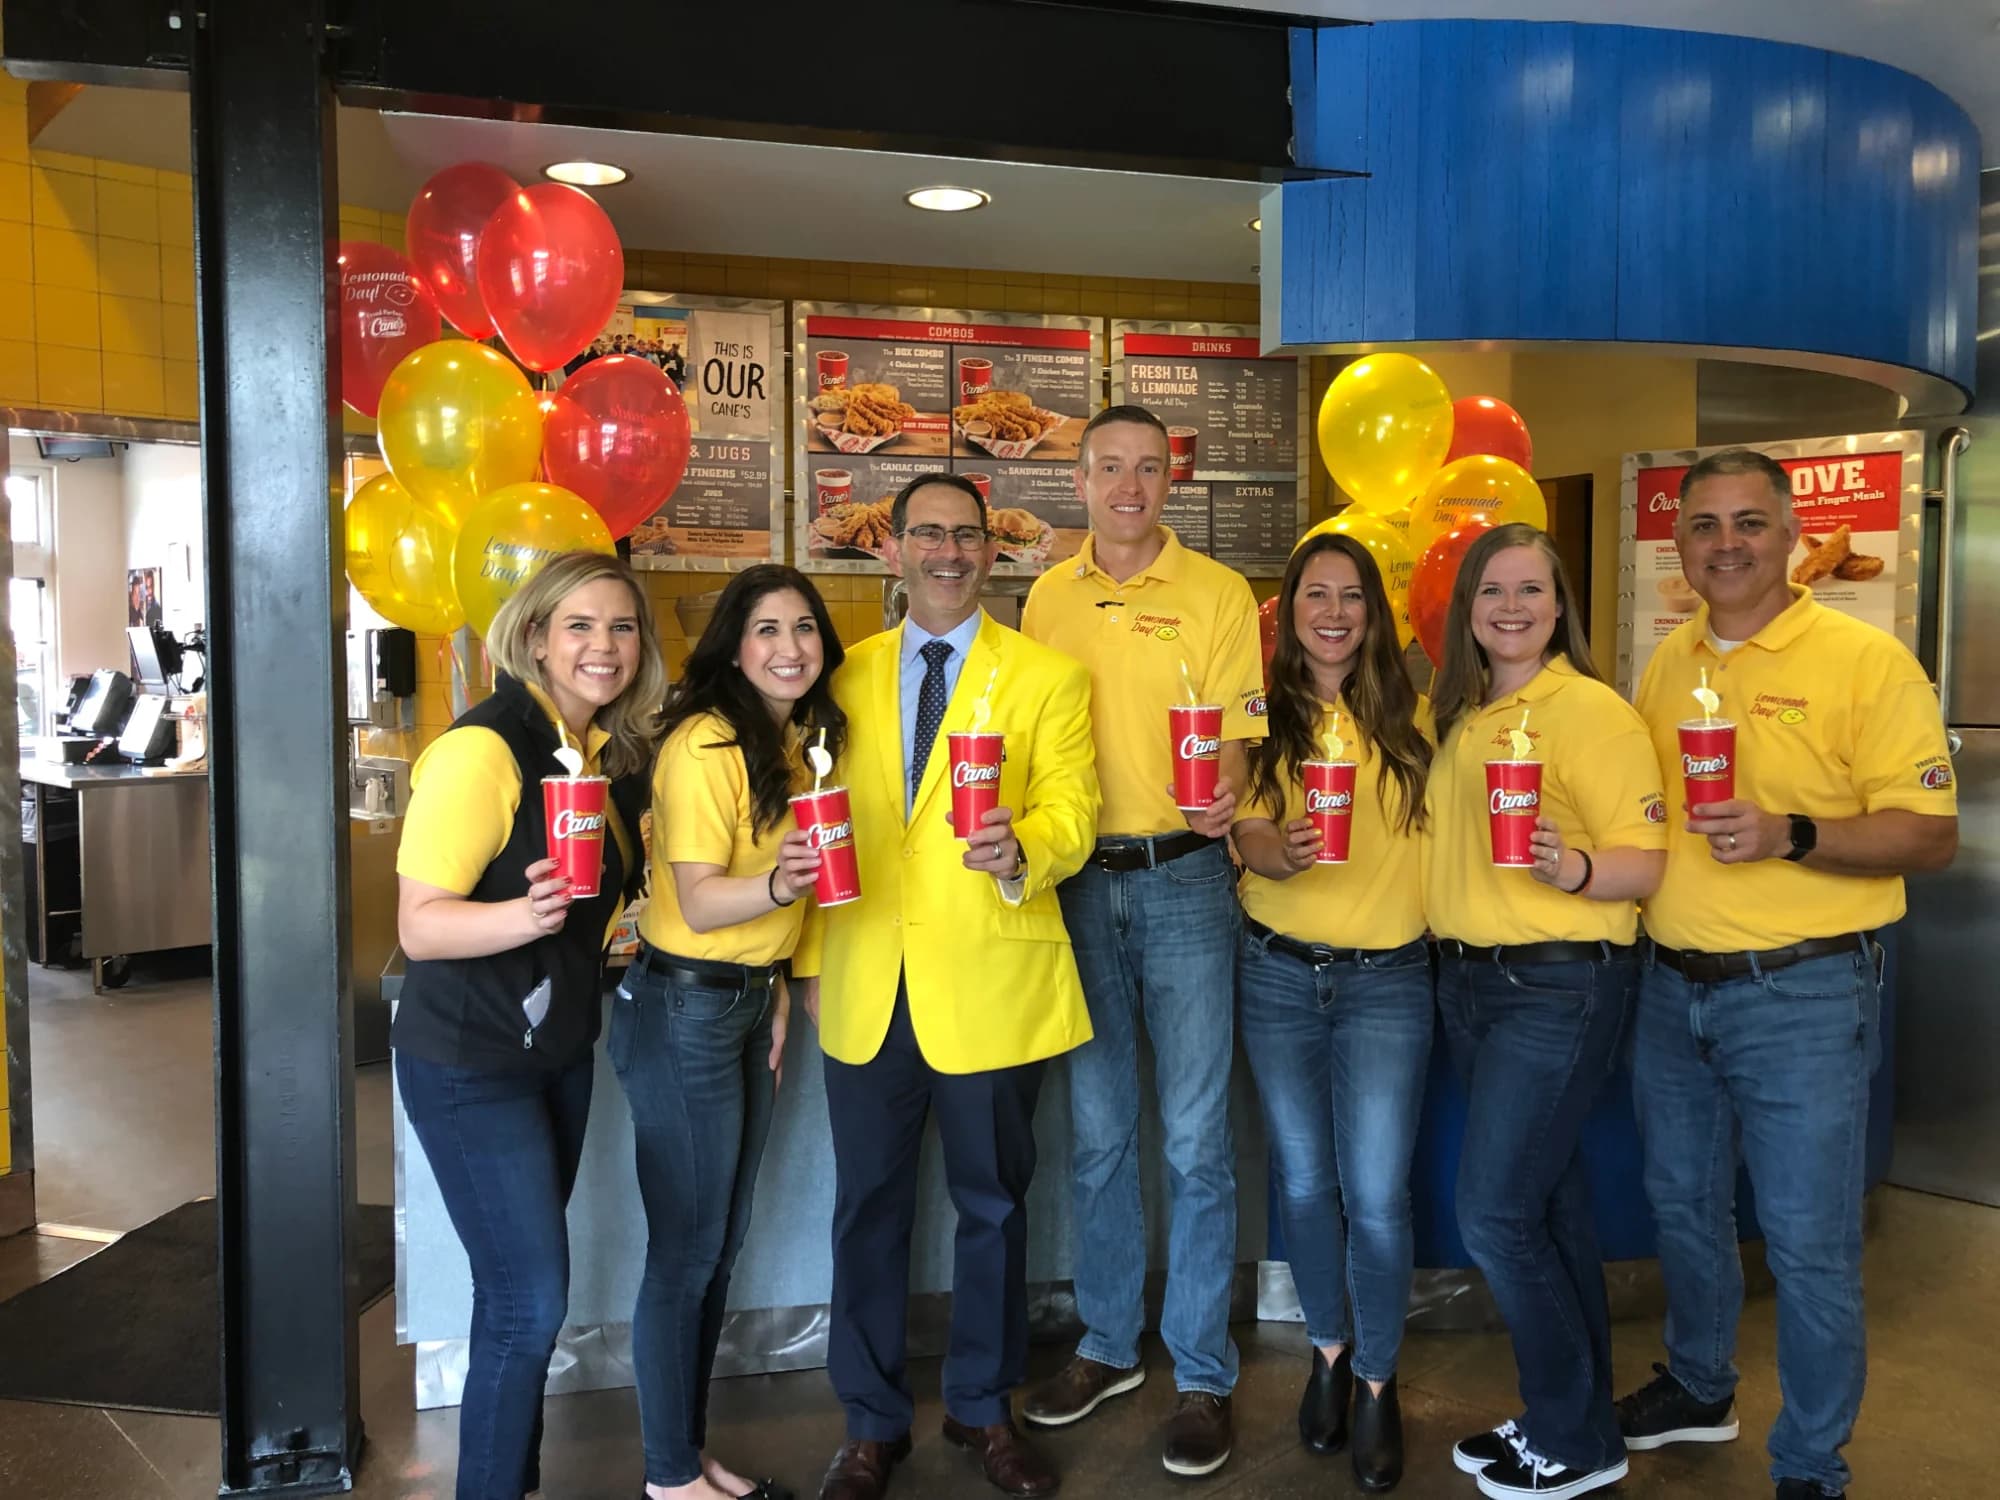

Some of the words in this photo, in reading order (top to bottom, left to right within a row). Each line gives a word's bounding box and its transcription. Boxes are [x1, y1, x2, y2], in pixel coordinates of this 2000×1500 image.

[928, 326, 975, 340] COMBOS
[714, 341, 739, 357] THIS
[743, 345, 754, 359] IS
[895, 347, 912, 357] BOX
[914, 348, 944, 358] COMBO
[1191, 342, 1232, 353] DRINKS
[895, 361, 919, 369] Chicken
[920, 362, 944, 370] Fingers
[1022, 354, 1054, 364] FINGER
[1055, 356, 1084, 365] COMBO
[703, 358, 766, 400] OUR
[819, 372, 846, 386] Cane's
[1037, 367, 1060, 375] Chicken
[1061, 368, 1084, 377] Fingers
[1131, 364, 1171, 380] FRESH
[1174, 366, 1198, 380] TEA
[960, 381, 989, 395] Cane's
[1131, 382, 1140, 393] &
[1142, 382, 1198, 395] LEMONADE
[711, 401, 751, 419] CANE'S
[918, 422, 949, 430] FAVORITE
[689, 445, 701, 458] &
[708, 445, 751, 461] JUGS
[1169, 451, 1193, 465] ane's
[690, 467, 736, 479] FINGERS
[881, 462, 912, 472] CANIAC
[914, 463, 944, 473] COMBO
[1008, 466, 1053, 476] SANDWICH
[1054, 467, 1075, 477] COM
[1060, 481, 1075, 489] Fing
[1180, 486, 1208, 496] COMBO
[1235, 487, 1275, 497] EXTRAS
[820, 491, 849, 505] Cane's
[1436, 496, 1504, 509] Lemonade
[1649, 492, 1680, 513] Our
[1791, 499, 1816, 509] cken
[1817, 496, 1851, 506] Finger
[1853, 490, 1885, 501] Meals
[1391, 576, 1409, 592] Da
[1135, 611, 1182, 627] Lemonade
[1682, 753, 1730, 778] Cane's
[953, 761, 1000, 788] Cane's
[1306, 788, 1352, 813] Cane's
[1490, 788, 1538, 815] Cane's
